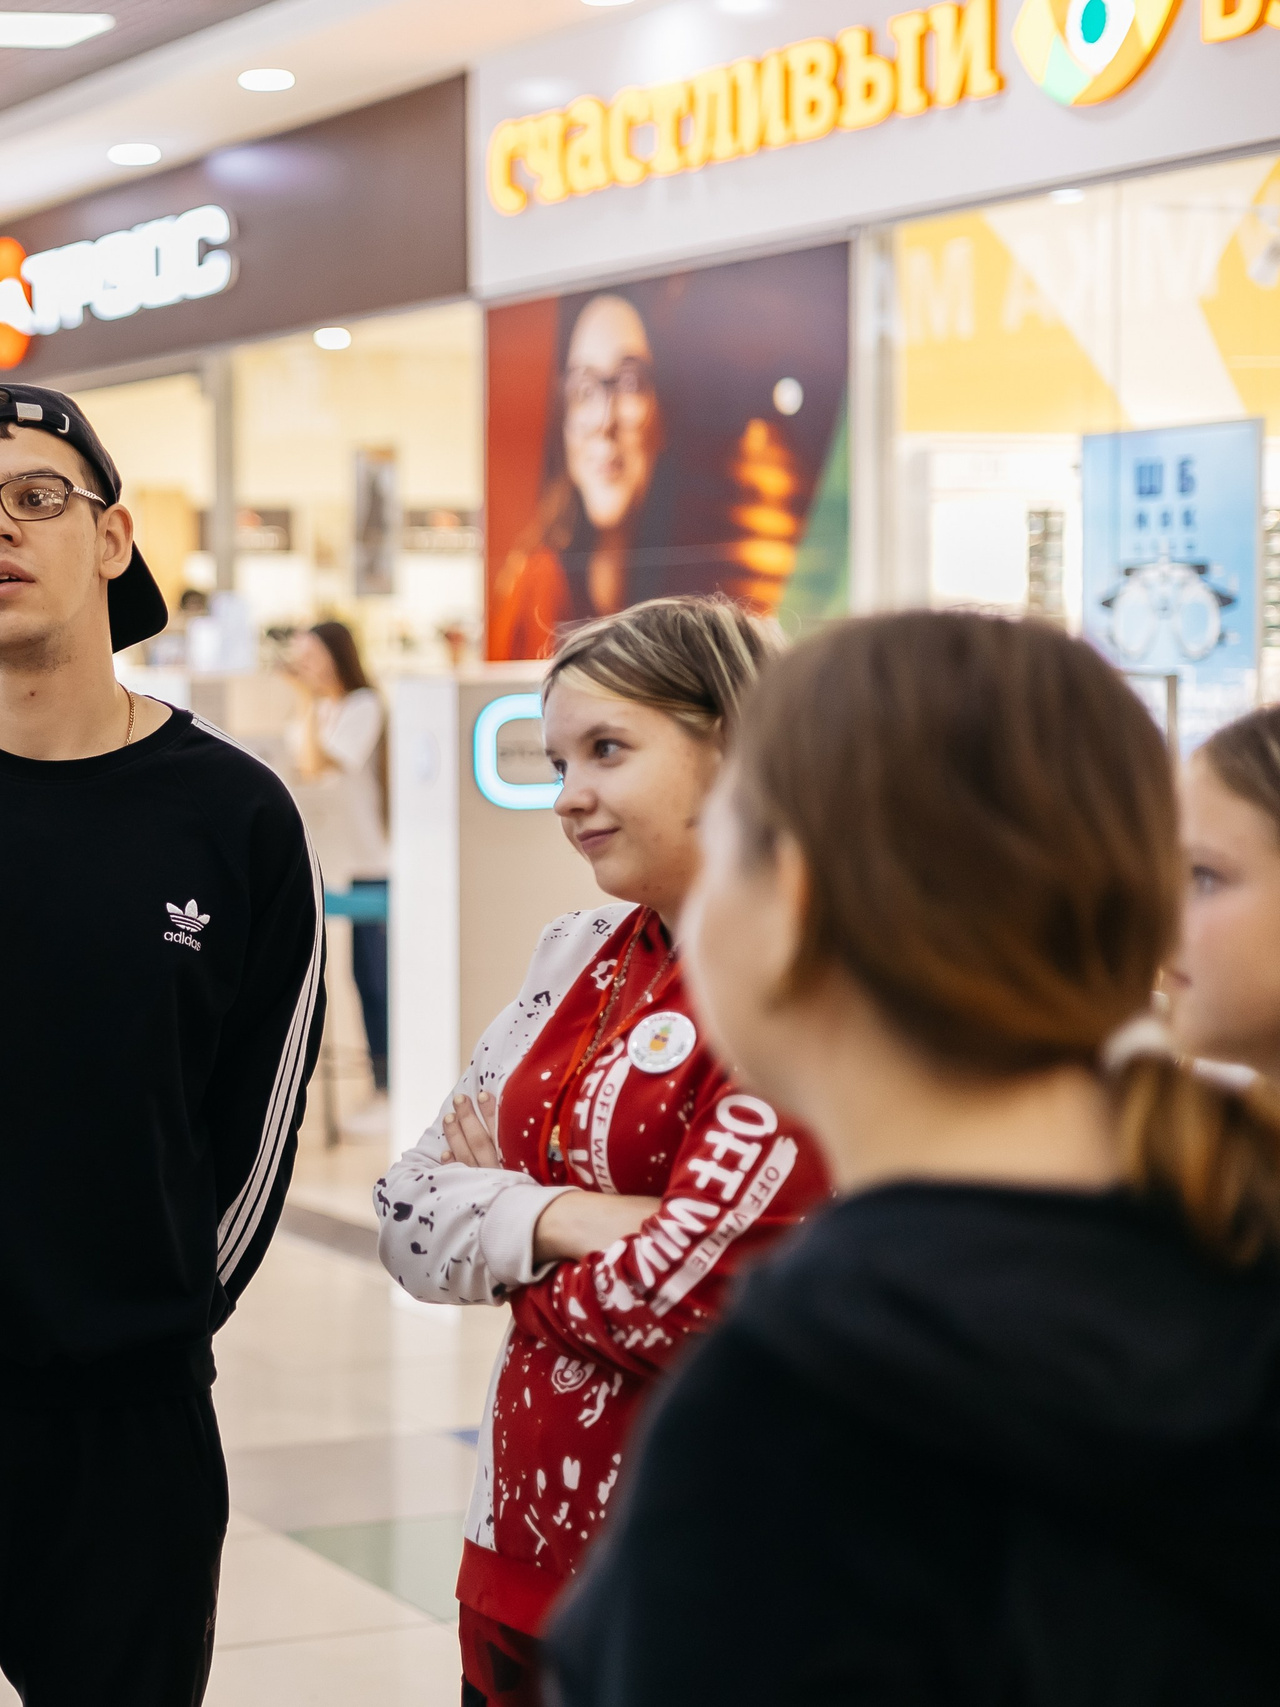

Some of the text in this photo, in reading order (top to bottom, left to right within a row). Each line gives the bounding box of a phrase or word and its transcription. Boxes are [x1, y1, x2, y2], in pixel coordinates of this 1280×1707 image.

[163, 931, 202, 952] adidas
[596, 1083, 616, 1127] OFF
[687, 1094, 779, 1202] OFF
[750, 1166, 780, 1208] OFF
